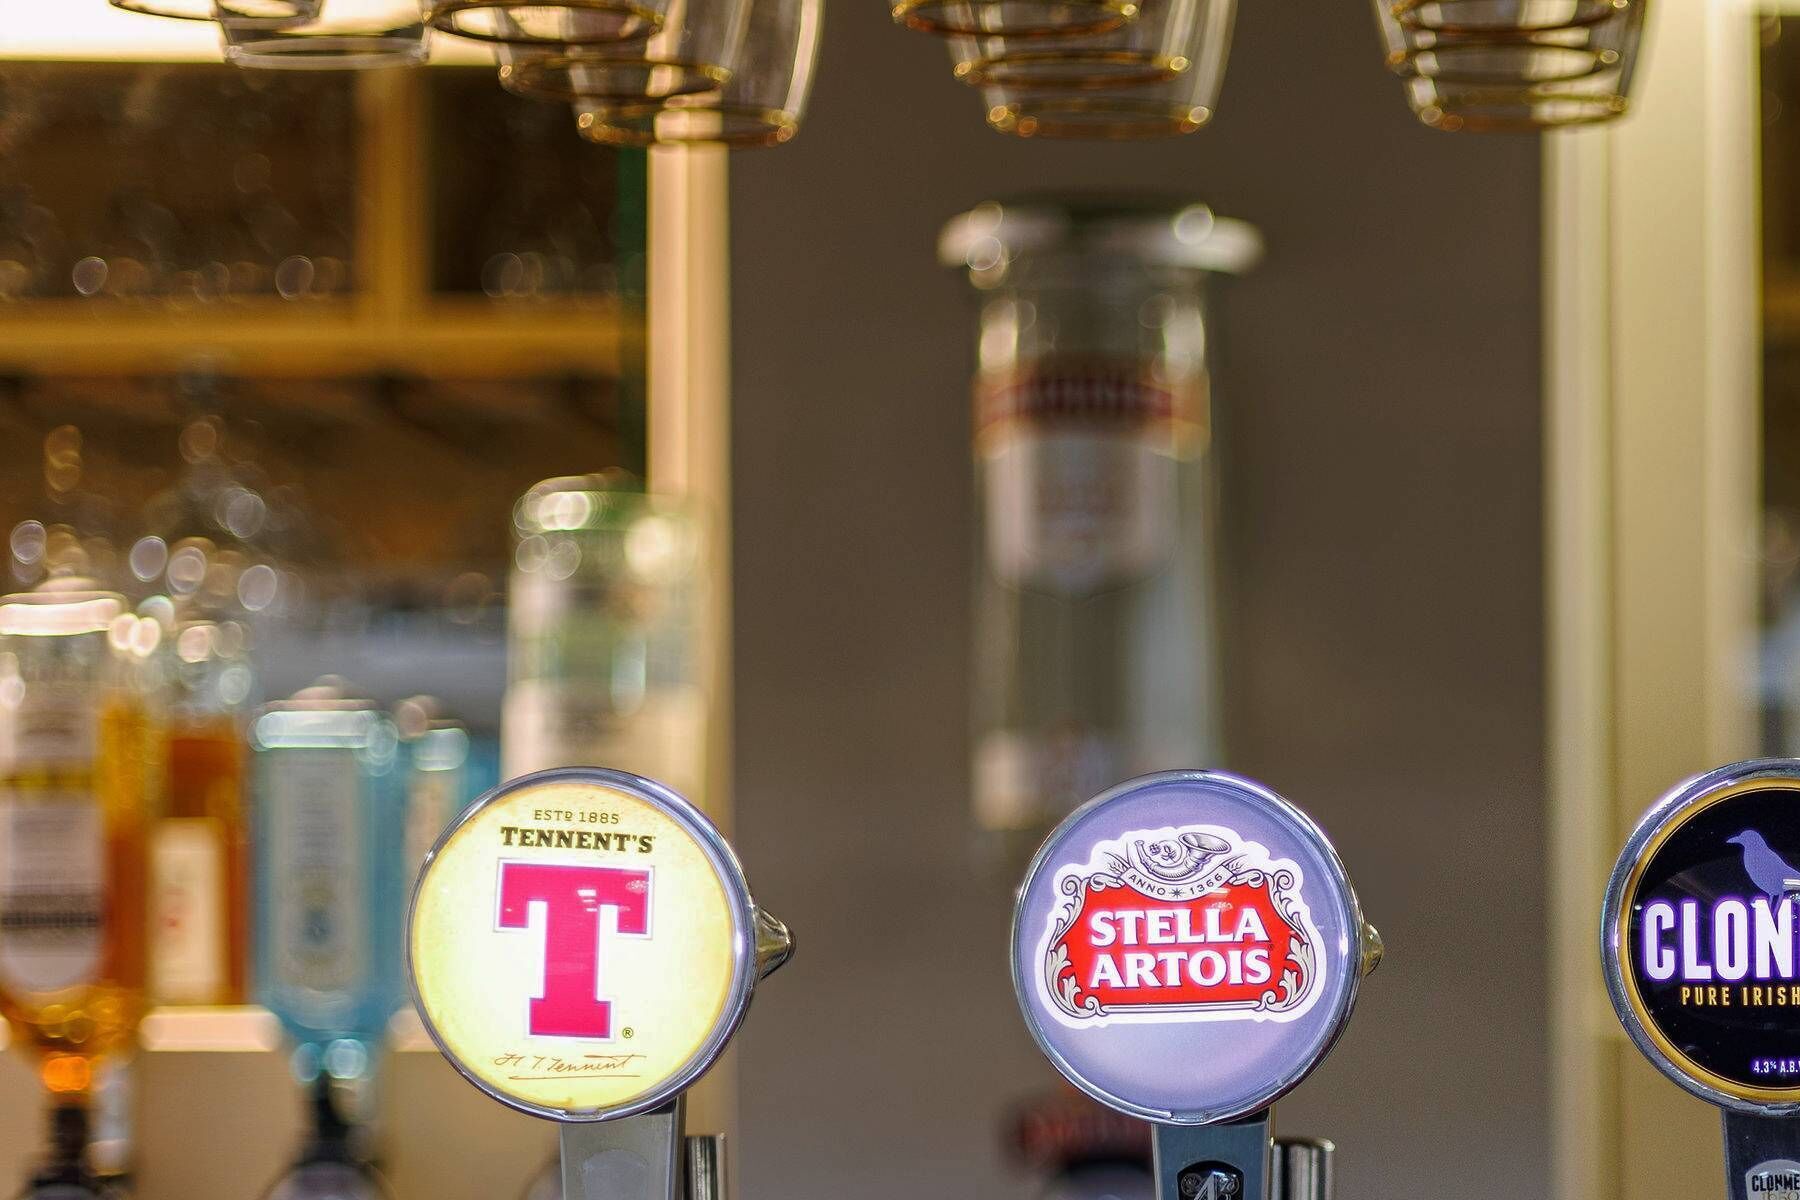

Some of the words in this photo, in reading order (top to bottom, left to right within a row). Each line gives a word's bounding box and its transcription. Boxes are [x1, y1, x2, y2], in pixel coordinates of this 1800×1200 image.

[579, 811, 620, 825] 1885
[500, 826, 656, 854] TENNENT'S
[1128, 874, 1166, 896] ANNO
[1189, 873, 1222, 895] 1366
[1090, 907, 1271, 947] STELLA
[497, 862, 649, 1040] T
[1089, 949, 1273, 988] ARTOIS
[1682, 986, 1730, 1006] PURE
[1743, 986, 1800, 1006] IRISH
